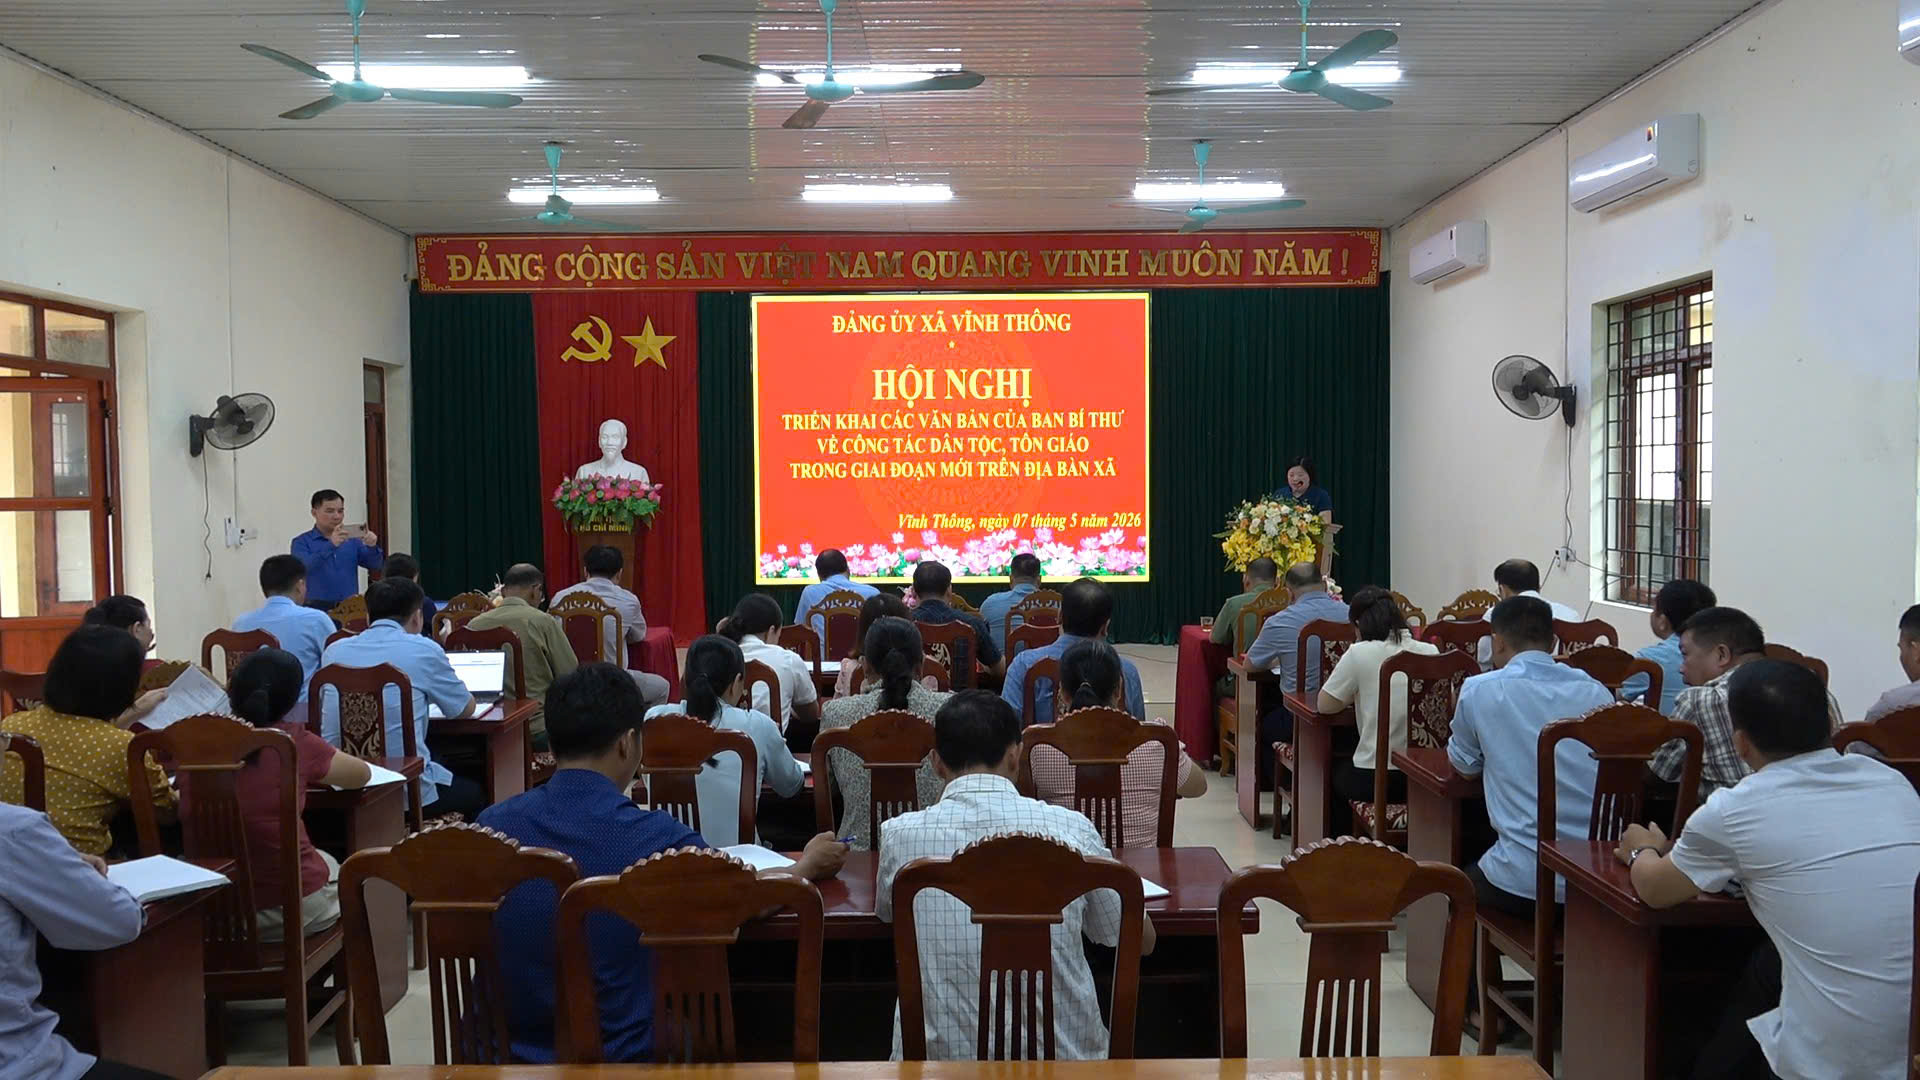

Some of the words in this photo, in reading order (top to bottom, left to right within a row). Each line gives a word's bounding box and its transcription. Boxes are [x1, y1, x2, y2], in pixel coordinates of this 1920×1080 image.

[446, 241, 546, 281] ĐẢNG
[555, 244, 649, 288] CỘNG
[656, 240, 726, 280] SẢN
[736, 242, 816, 285] VIỆT
[826, 251, 905, 279] NAM
[911, 250, 1032, 281] QUANG
[1041, 248, 1129, 277] VINH
[1138, 240, 1243, 277] MUÔN
[1252, 241, 1333, 276] NĂM
[1341, 248, 1349, 276] !
[832, 310, 886, 333] ĐẢNG
[891, 310, 916, 332] ỦY
[921, 310, 947, 332] XÃ
[952, 310, 999, 332] VĨNH
[1004, 308, 1071, 332] THÔNG
[872, 364, 936, 408] HỘI
[944, 367, 1032, 408] NGHỊ
[835, 413, 876, 429] KHAI
[880, 409, 914, 429] CÁC
[918, 409, 952, 429] VĂN
[957, 409, 989, 428] BẢN
[993, 408, 1027, 428] CỦA
[1031, 412, 1064, 428] BAN
[1068, 408, 1084, 428] BÍ
[1088, 409, 1125, 428] THƯ
[842, 434, 889, 454] CÔNG
[893, 434, 926, 453] TÁC
[930, 432, 964, 453] DÂN
[1010, 432, 1043, 453] TÔN
[1047, 433, 1089, 453] GIÁO
[790, 463, 847, 478] TRONG
[851, 462, 886, 478] GIAI
[890, 462, 935, 481] ĐOẠN
[940, 457, 972, 477] MỚI
[977, 457, 1020, 477] TRÊN
[1025, 461, 1053, 480] ĐỊA
[1057, 457, 1089, 476] BÀN
[1094, 457, 1116, 476] XÃ
[898, 513, 928, 529] Vĩnh
[932, 514, 975, 531] Thông,
[979, 514, 1009, 532] ngày
[1013, 513, 1028, 528] 07
[1031, 513, 1066, 531] tháng
[1070, 513, 1077, 528] 5
[1081, 514, 1108, 528] năm
[1112, 512, 1141, 528] 2026
